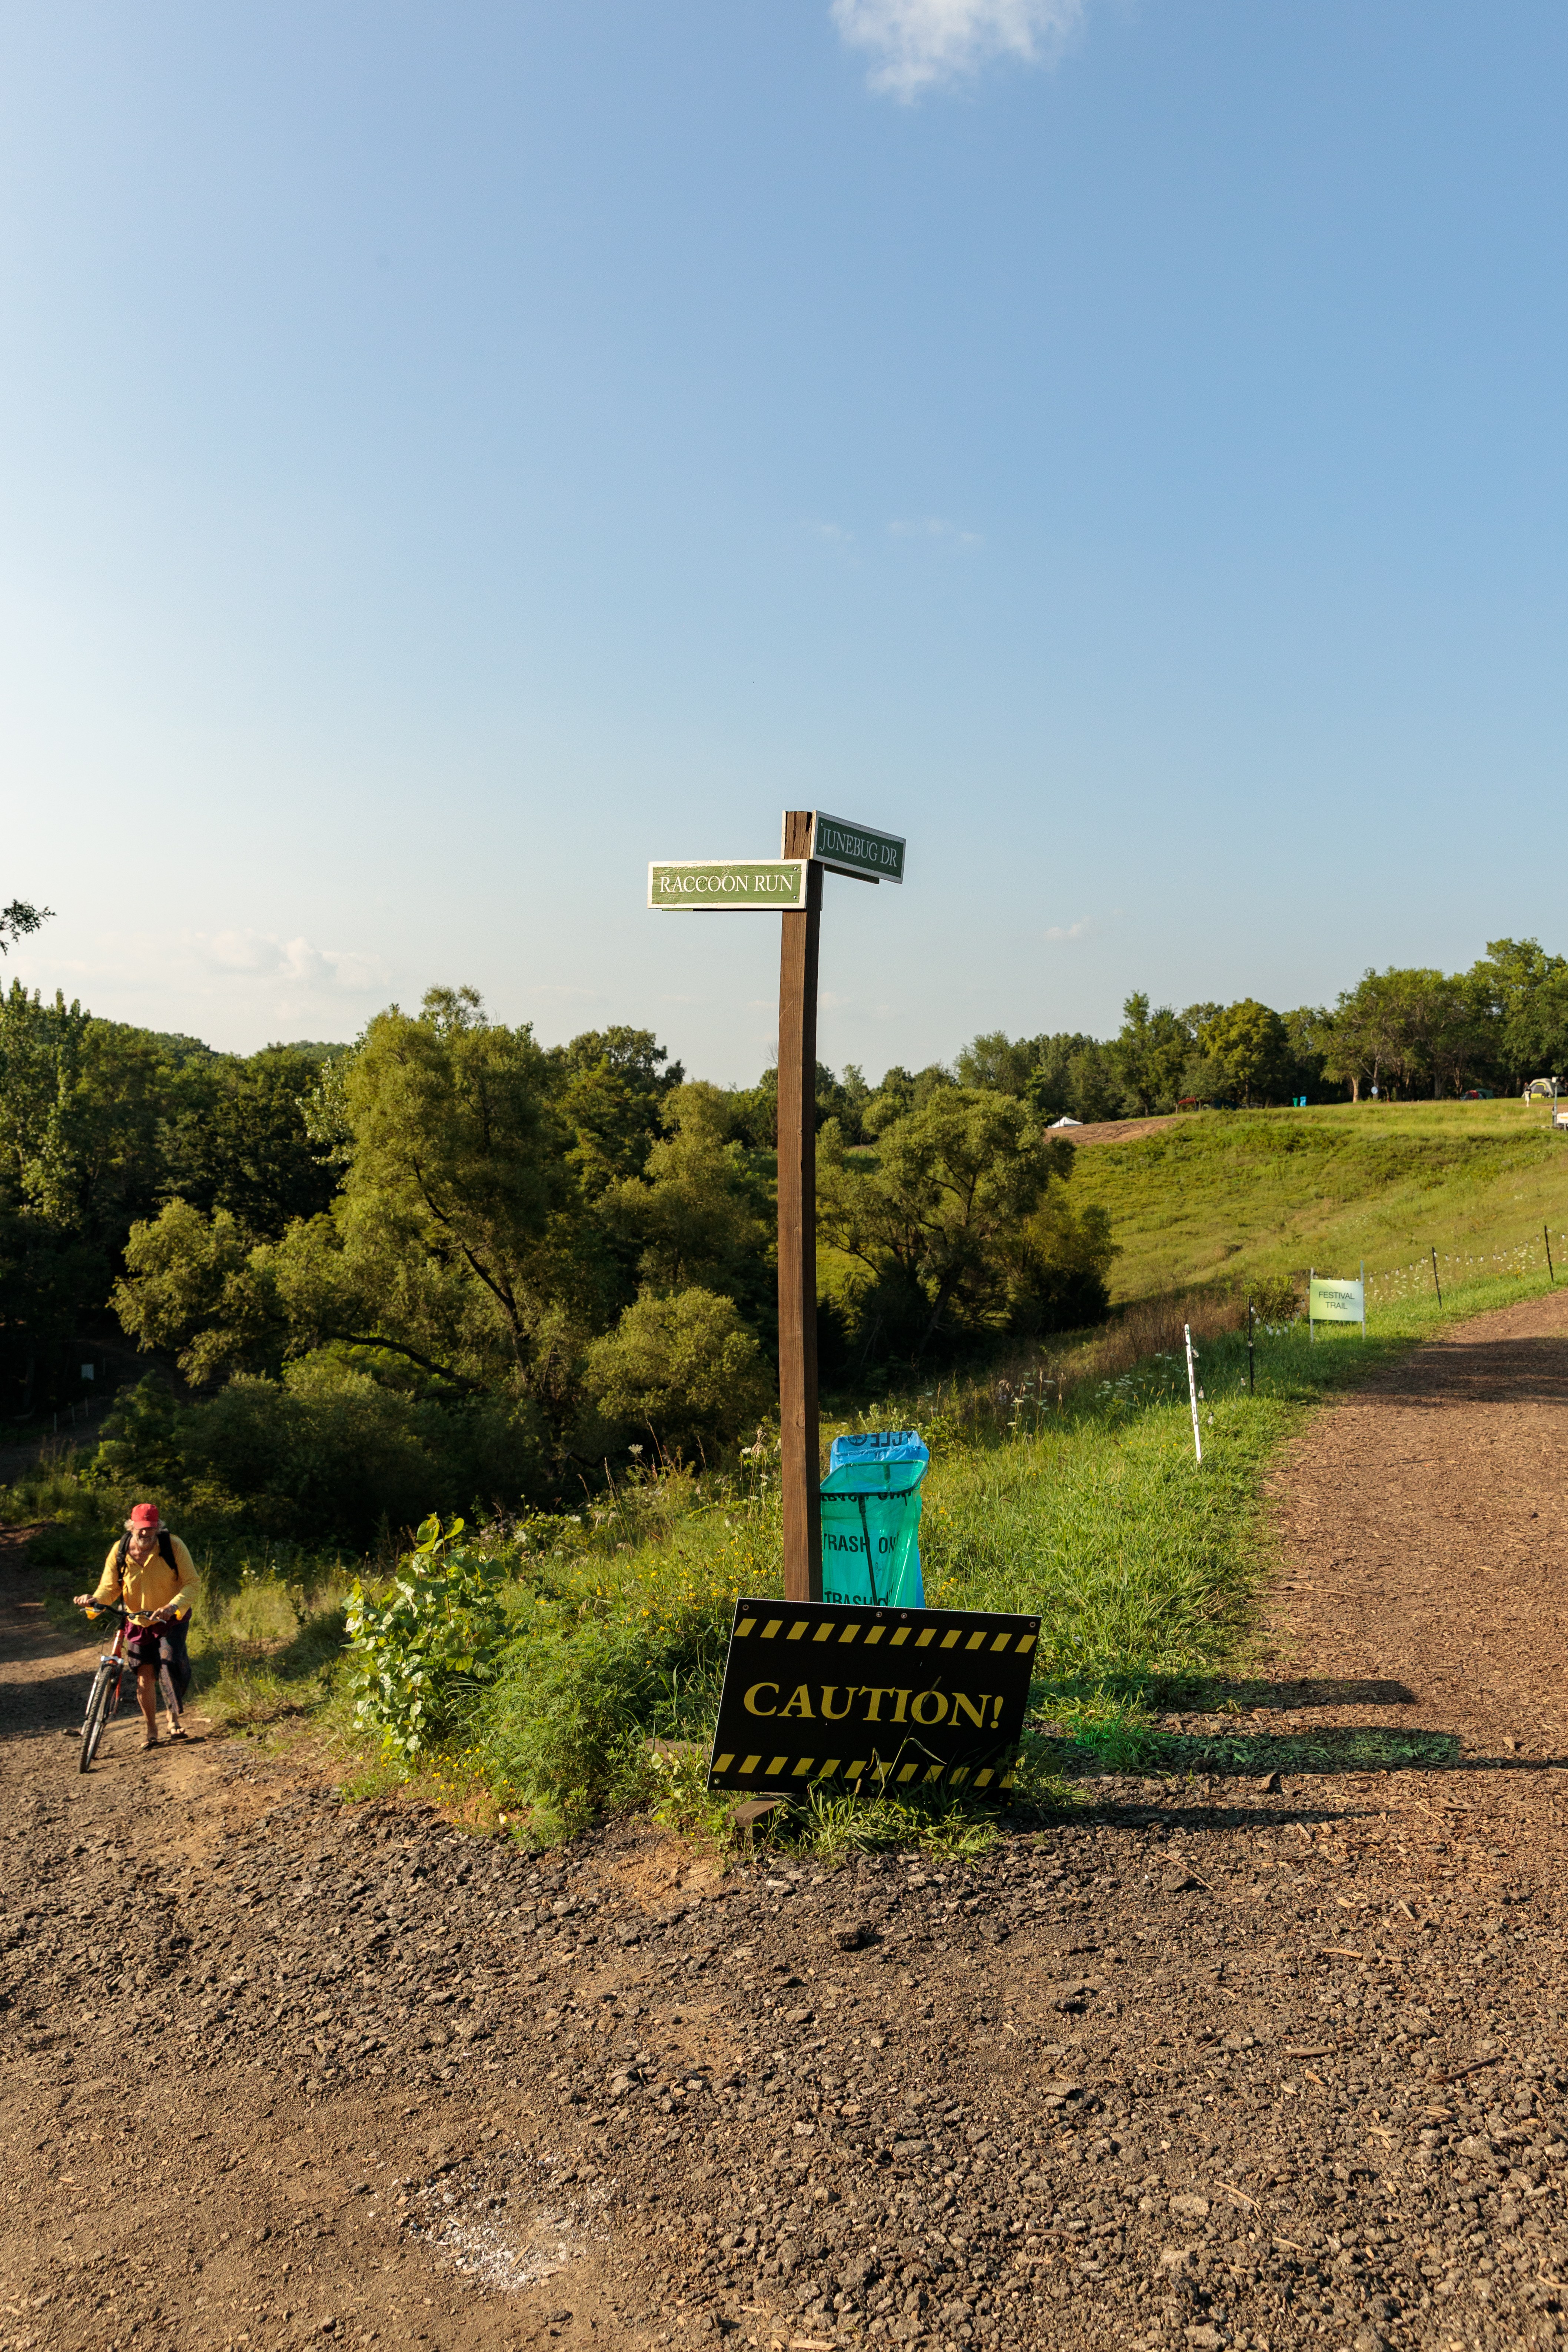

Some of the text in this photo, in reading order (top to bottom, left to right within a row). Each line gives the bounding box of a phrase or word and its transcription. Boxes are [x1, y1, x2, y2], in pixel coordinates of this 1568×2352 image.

[819, 828, 898, 867] JUNEBUG DR
[660, 875, 794, 893] RACCOON RUN
[1319, 1291, 1355, 1300] FESTIVAL
[824, 1531, 899, 1554] TRASH ON
[744, 1682, 1004, 1729] CAUTION!
